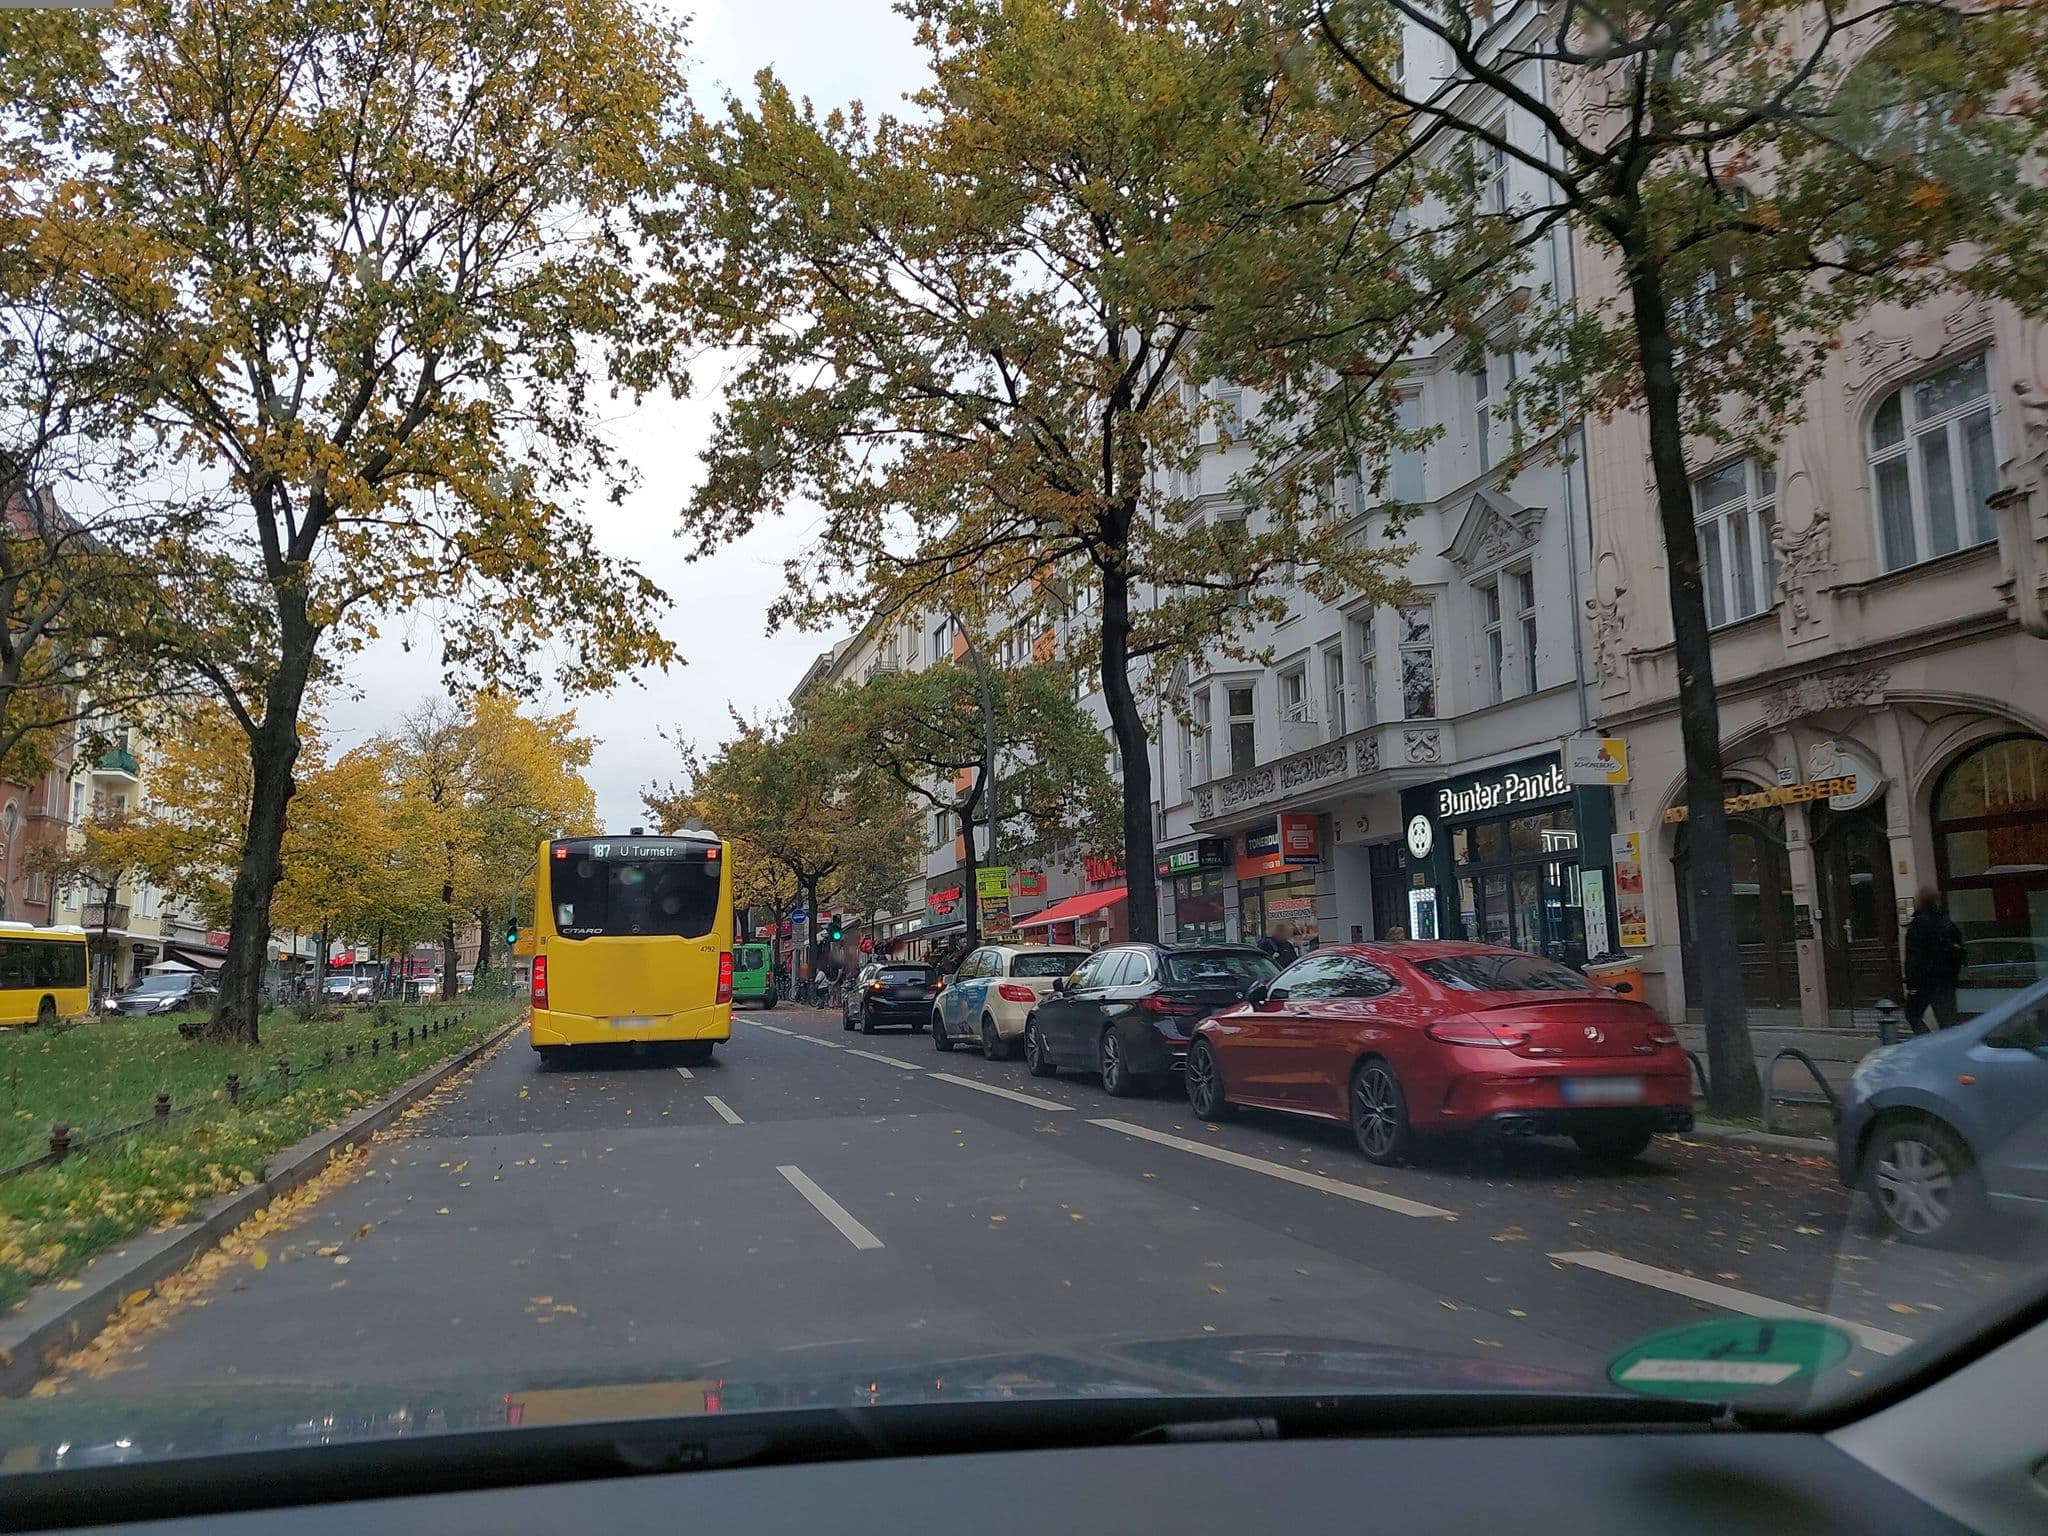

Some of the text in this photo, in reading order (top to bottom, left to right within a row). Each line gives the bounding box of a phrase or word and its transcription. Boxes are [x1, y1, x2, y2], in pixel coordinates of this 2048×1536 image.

[1439, 763, 1572, 818] Bunter Panda
[592, 844, 677, 858] 187 U Turmstr.
[700, 945, 716, 953] 4792
